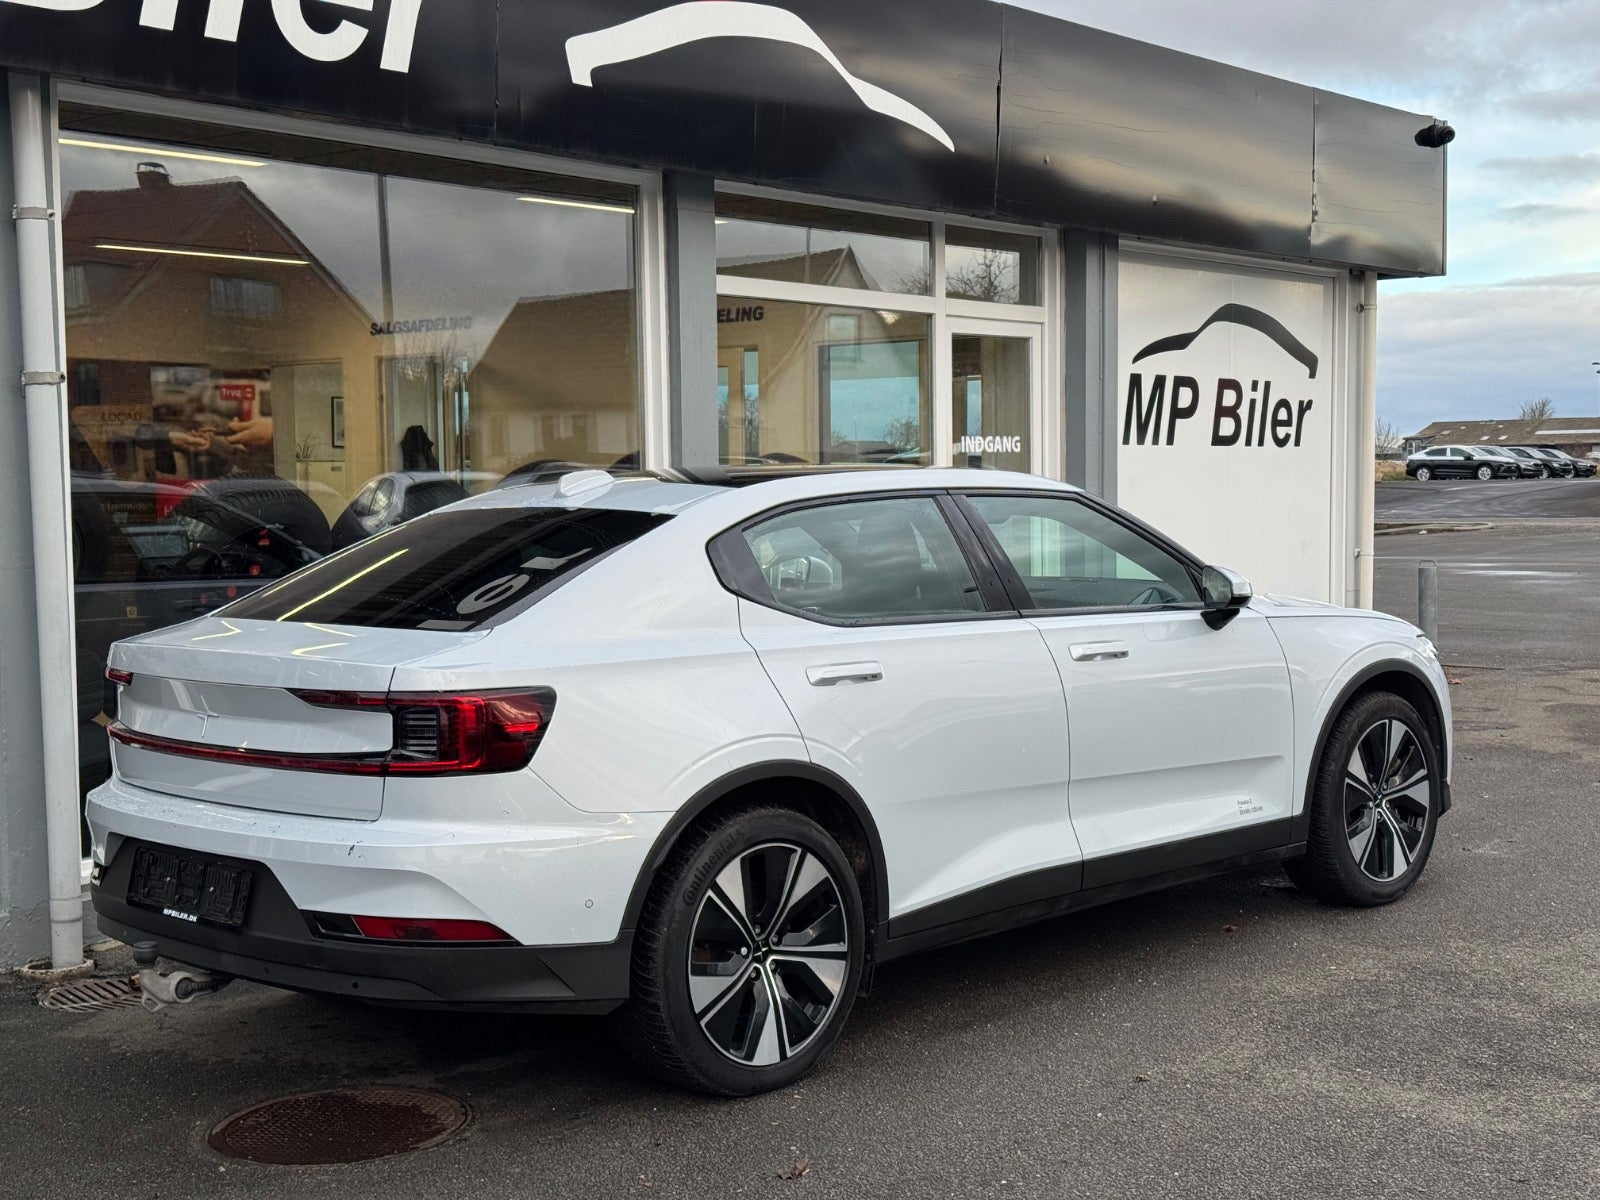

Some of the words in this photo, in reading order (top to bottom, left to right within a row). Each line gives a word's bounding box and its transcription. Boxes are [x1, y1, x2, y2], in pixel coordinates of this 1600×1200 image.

[1122, 373, 1200, 446] MP
[1211, 378, 1314, 448] Biler
[961, 436, 1021, 453] INDGANG
